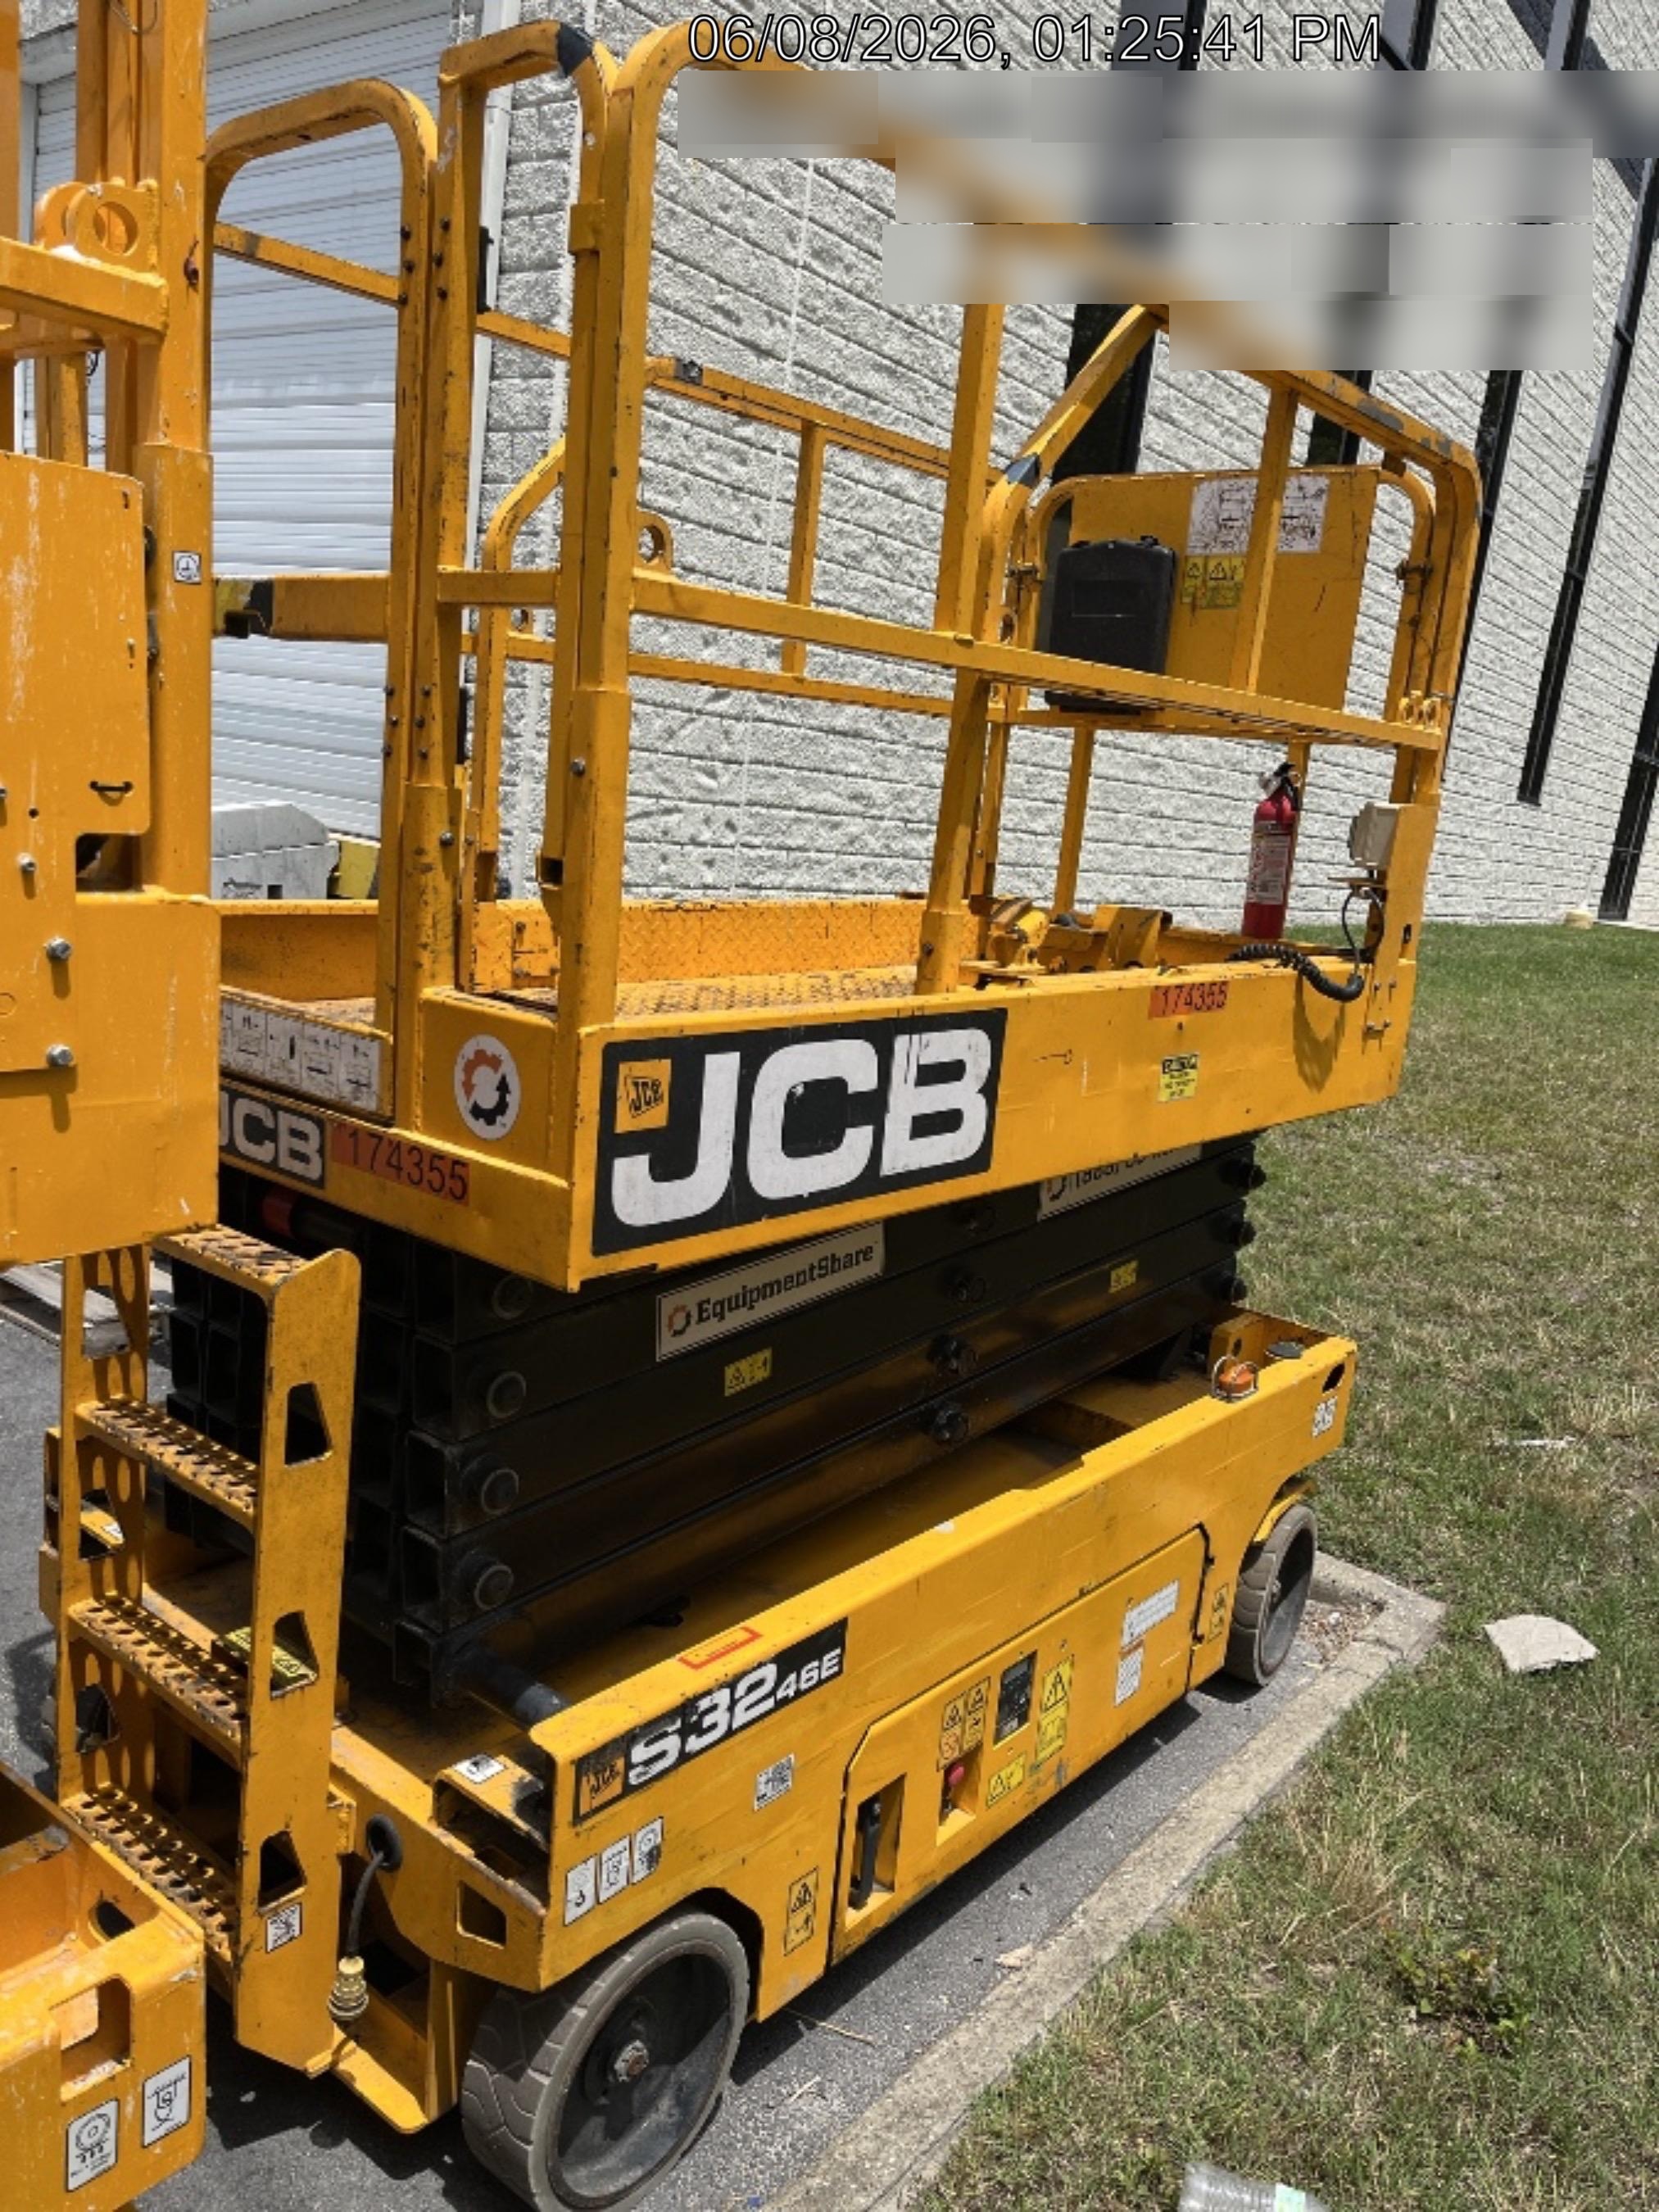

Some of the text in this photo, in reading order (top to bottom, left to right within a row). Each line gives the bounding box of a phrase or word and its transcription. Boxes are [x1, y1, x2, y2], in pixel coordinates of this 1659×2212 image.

[1163, 981, 1227, 1016] 174355
[611, 1028, 992, 1227] JCB
[629, 1077, 663, 1113] JCB
[348, 1129, 469, 1201] 174355
[695, 1244, 874, 1325] EquipmentShare
